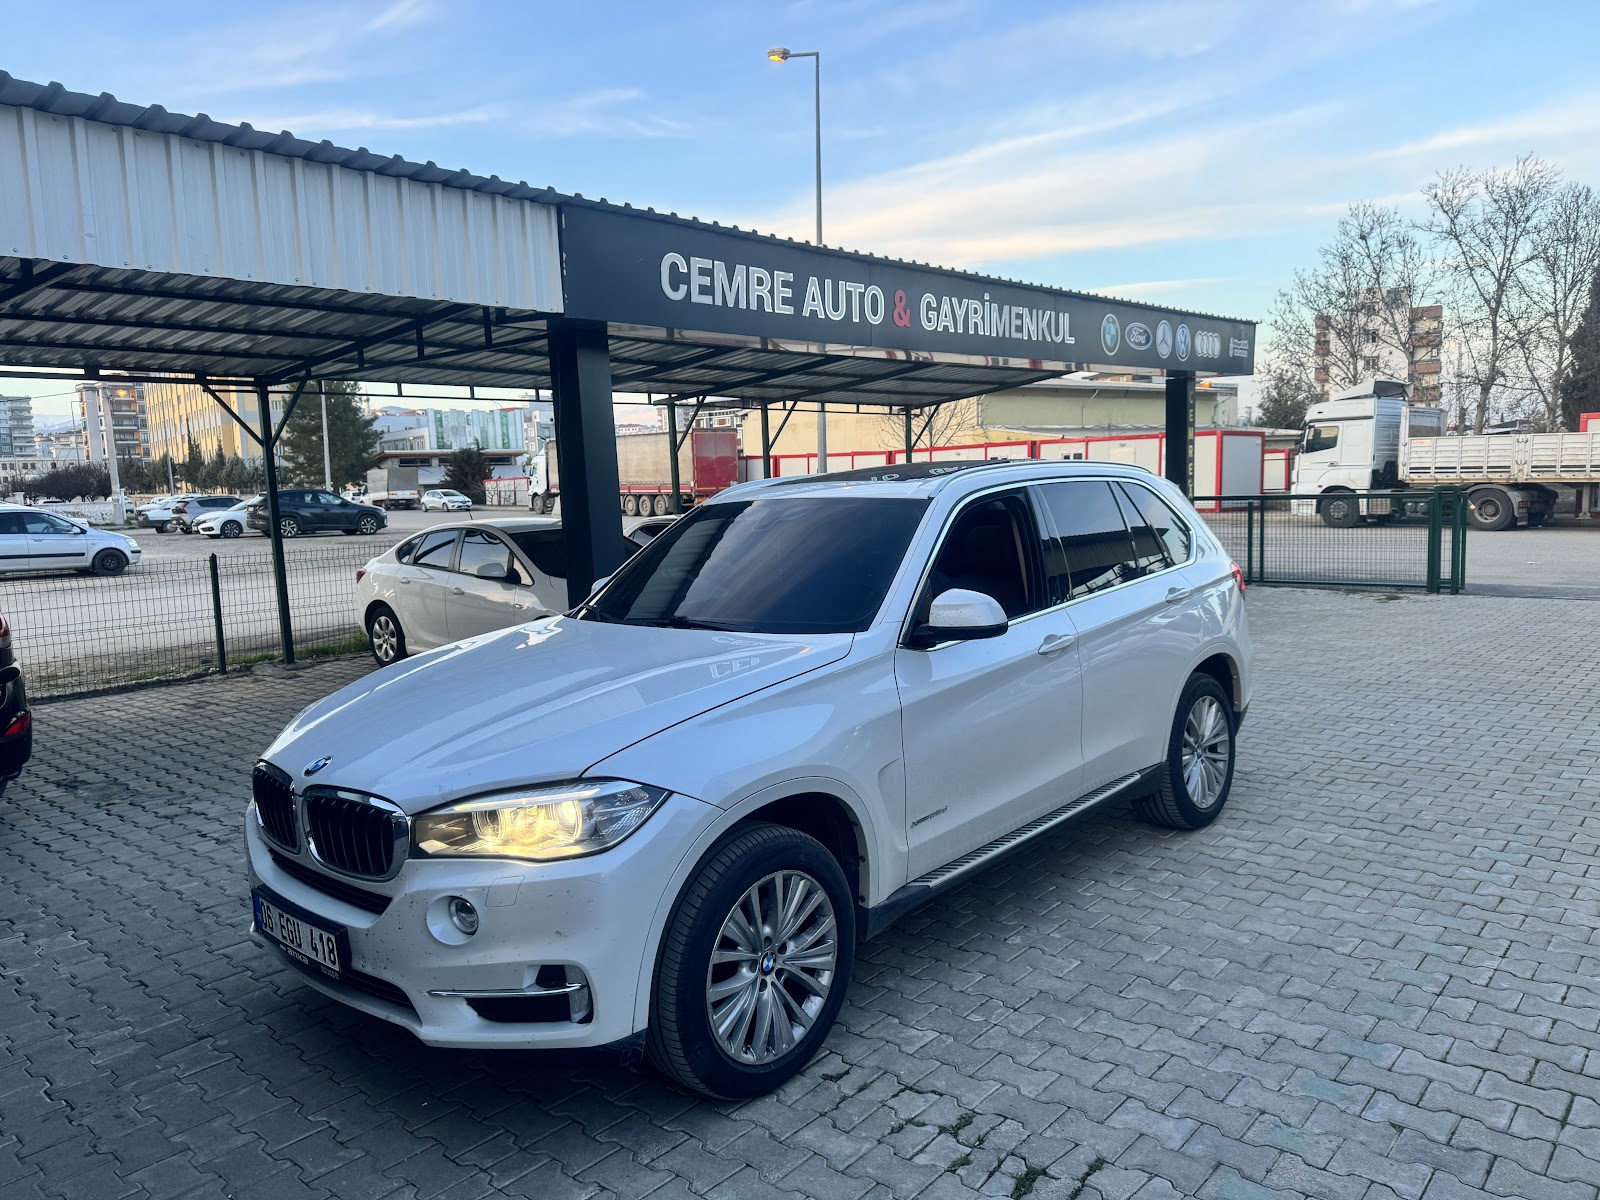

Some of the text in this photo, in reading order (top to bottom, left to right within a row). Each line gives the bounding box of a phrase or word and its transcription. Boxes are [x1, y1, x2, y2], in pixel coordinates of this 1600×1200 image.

[660, 252, 1075, 345] CEMRE AUTO & GAYRİMENKUL
[1130, 326, 1148, 344] Ford
[260, 900, 337, 965] 06 EGU 418
